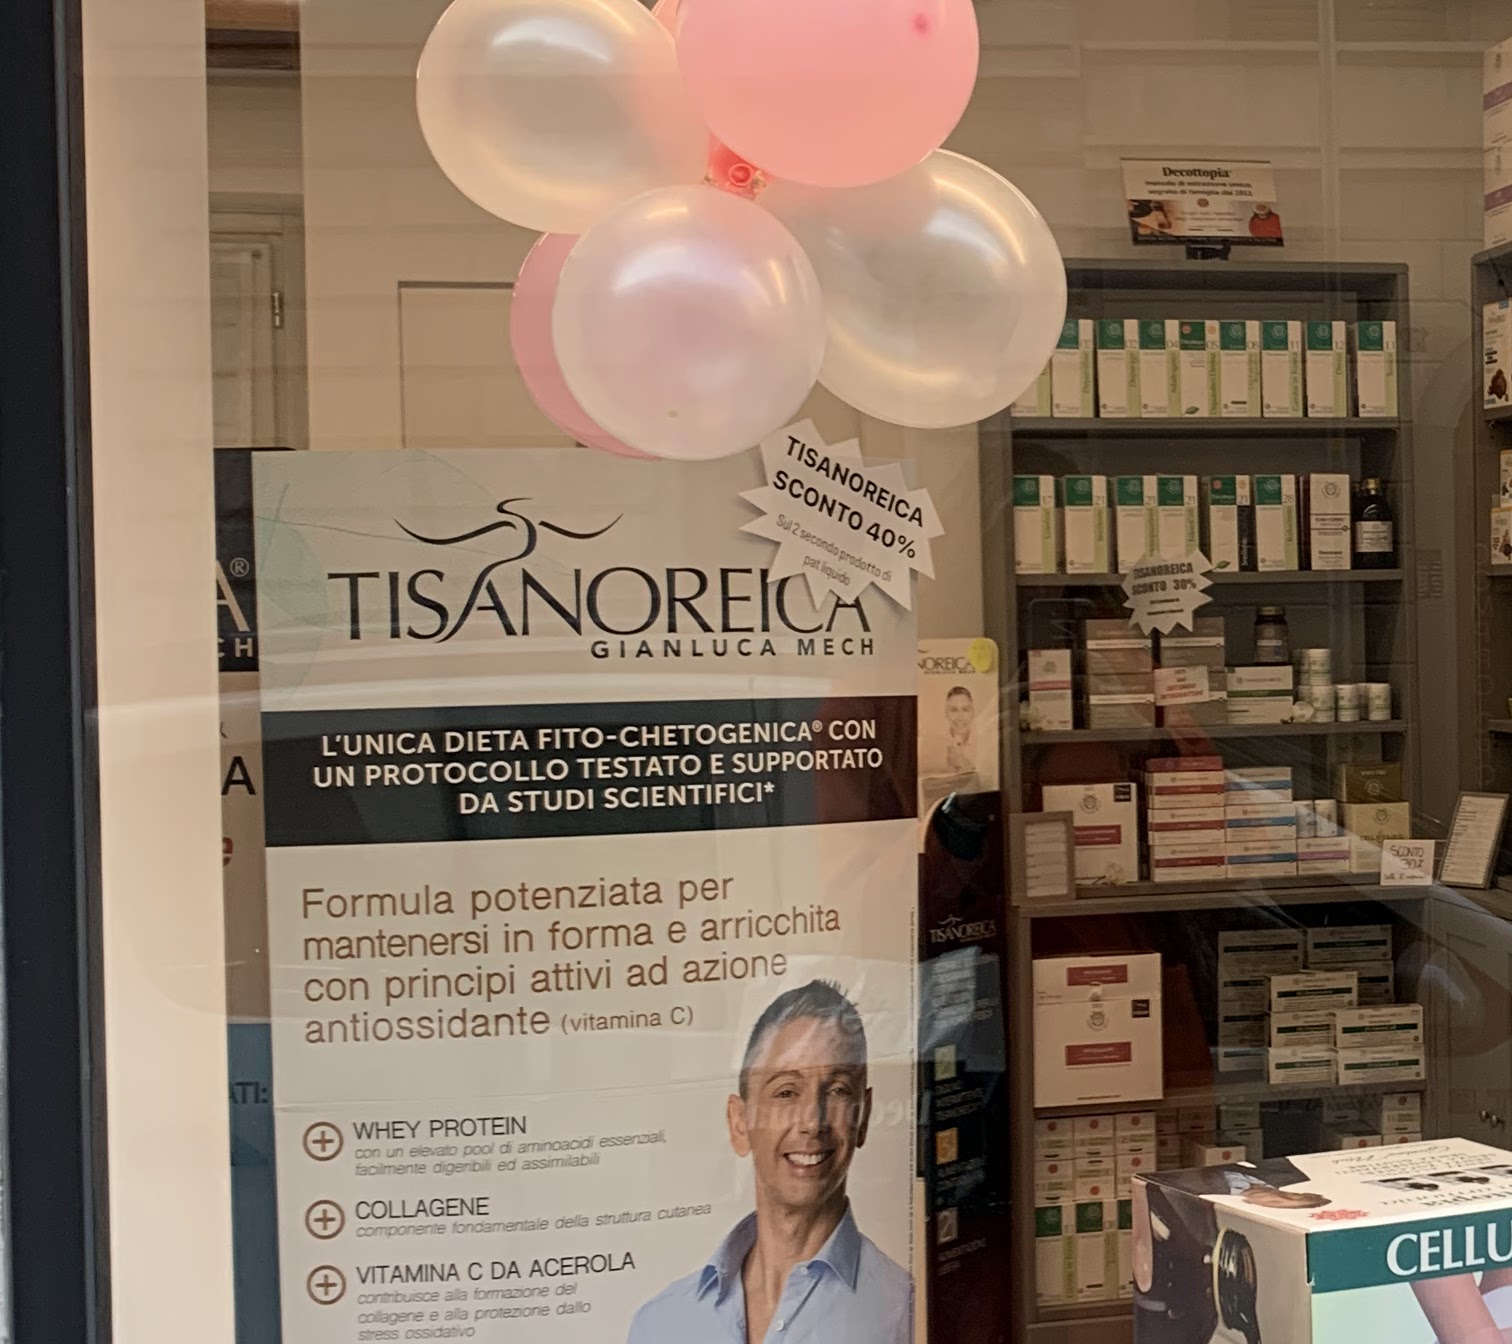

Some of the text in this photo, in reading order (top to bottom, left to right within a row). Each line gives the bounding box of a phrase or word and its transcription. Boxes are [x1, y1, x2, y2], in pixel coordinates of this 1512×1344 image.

[788, 435, 923, 527] TISANOREICA
[773, 470, 916, 558] SCONTO 40%
[776, 514, 792, 532] Sul
[800, 529, 839, 556] secondo
[839, 549, 880, 578] prodotto
[882, 569, 892, 582] di
[821, 563, 850, 586] liquido
[328, 567, 871, 643] TISANOREICA
[590, 637, 875, 659] GIANLUCA MECH
[445, 728, 529, 753] DIETA
[829, 719, 876, 740] CON
[313, 748, 884, 789] UN PROTOCOLLO TESTATO E SUPPORTATO
[459, 792, 499, 815] DA
[507, 789, 595, 812] STUDI
[302, 875, 735, 920] Formula potenziata per
[303, 904, 841, 961] mantenersi in forma e arricchita
[303, 951, 788, 1006] con principi attivi ad azione
[305, 1005, 695, 1044] antiossidante (vitamina C)
[352, 1116, 527, 1141] WHEY PROTEIN
[409, 1143, 458, 1159] elevato
[463, 1141, 494, 1159] pool
[517, 1135, 595, 1154] aminoacidi
[599, 1129, 667, 1148] essenziali,
[355, 1197, 490, 1220] COLLAGENE
[356, 1251, 636, 1286] VITAMINA C DA ACEROLA
